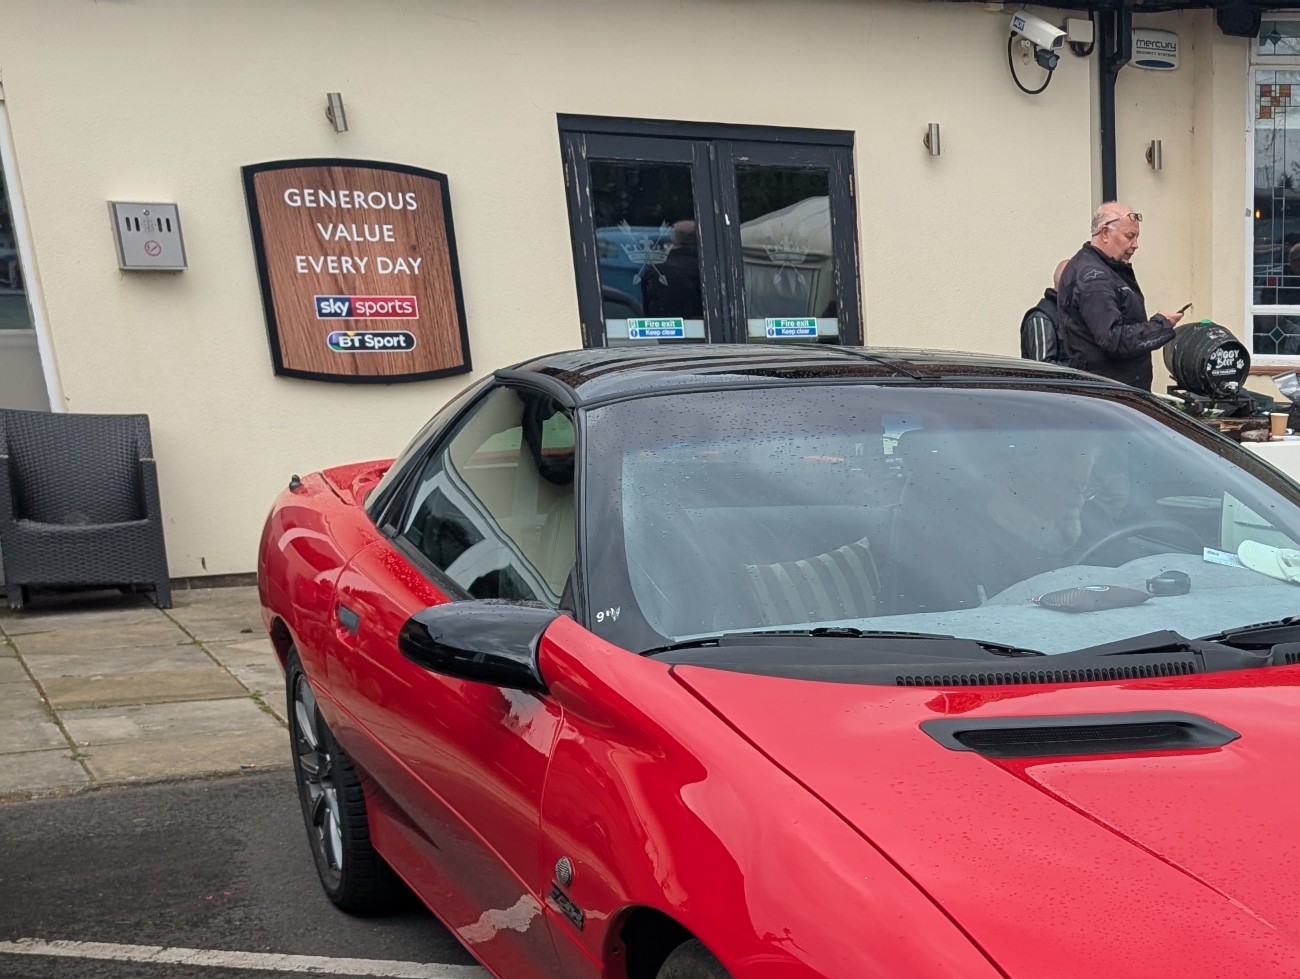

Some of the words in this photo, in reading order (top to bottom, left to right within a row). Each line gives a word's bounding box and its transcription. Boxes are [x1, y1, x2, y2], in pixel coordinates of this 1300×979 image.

[1136, 39, 1176, 52] mercury
[283, 188, 418, 211] GENEROUS
[316, 222, 396, 242] VALUE
[295, 255, 369, 274] EVERY
[376, 256, 422, 275] DAY
[320, 298, 350, 316] sky
[355, 300, 413, 316] sports
[644, 320, 660, 328] Fire
[780, 319, 796, 327] Fire
[796, 319, 810, 327] exit
[338, 336, 363, 348] BT
[364, 335, 407, 349] Sport
